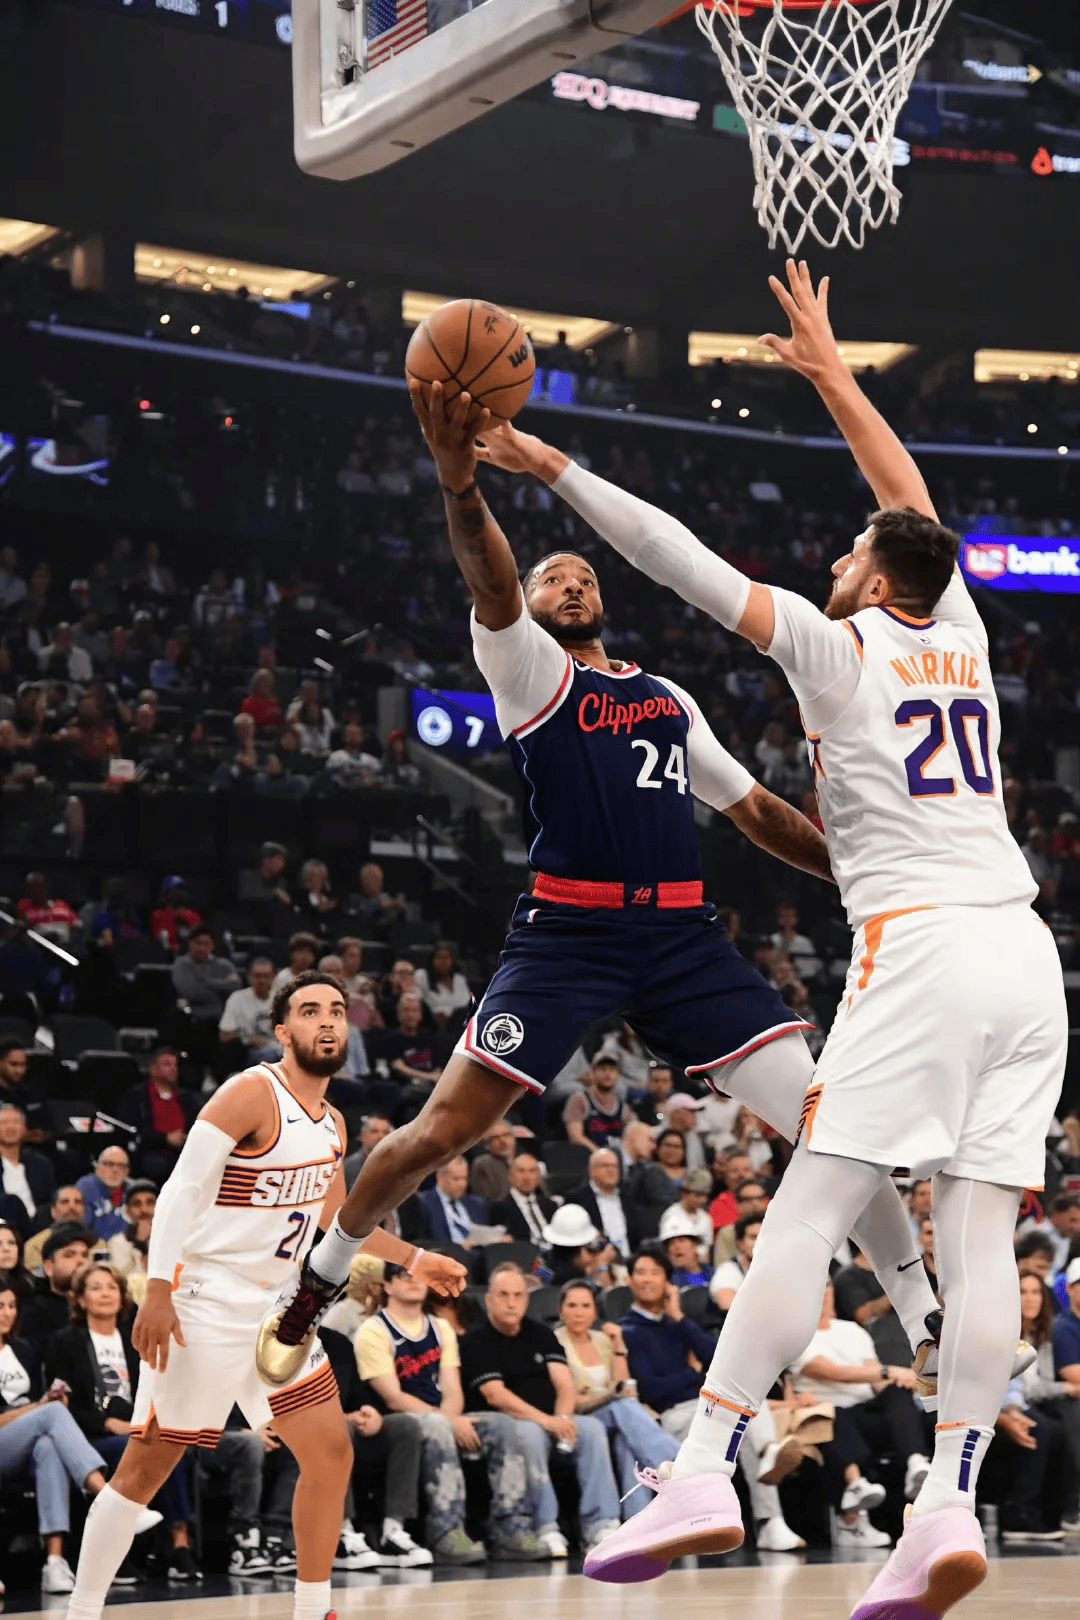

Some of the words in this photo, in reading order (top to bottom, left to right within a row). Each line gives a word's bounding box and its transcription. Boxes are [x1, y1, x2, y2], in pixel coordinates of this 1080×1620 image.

[215, 1, 228, 28] 1
[1007, 543, 1080, 577] bank
[890, 651, 980, 690] NURKIC
[464, 715, 485, 748] 7
[578, 692, 681, 735] Clippers
[631, 738, 688, 796] 24
[894, 698, 996, 799] 20
[250, 1162, 334, 1207] SUNS
